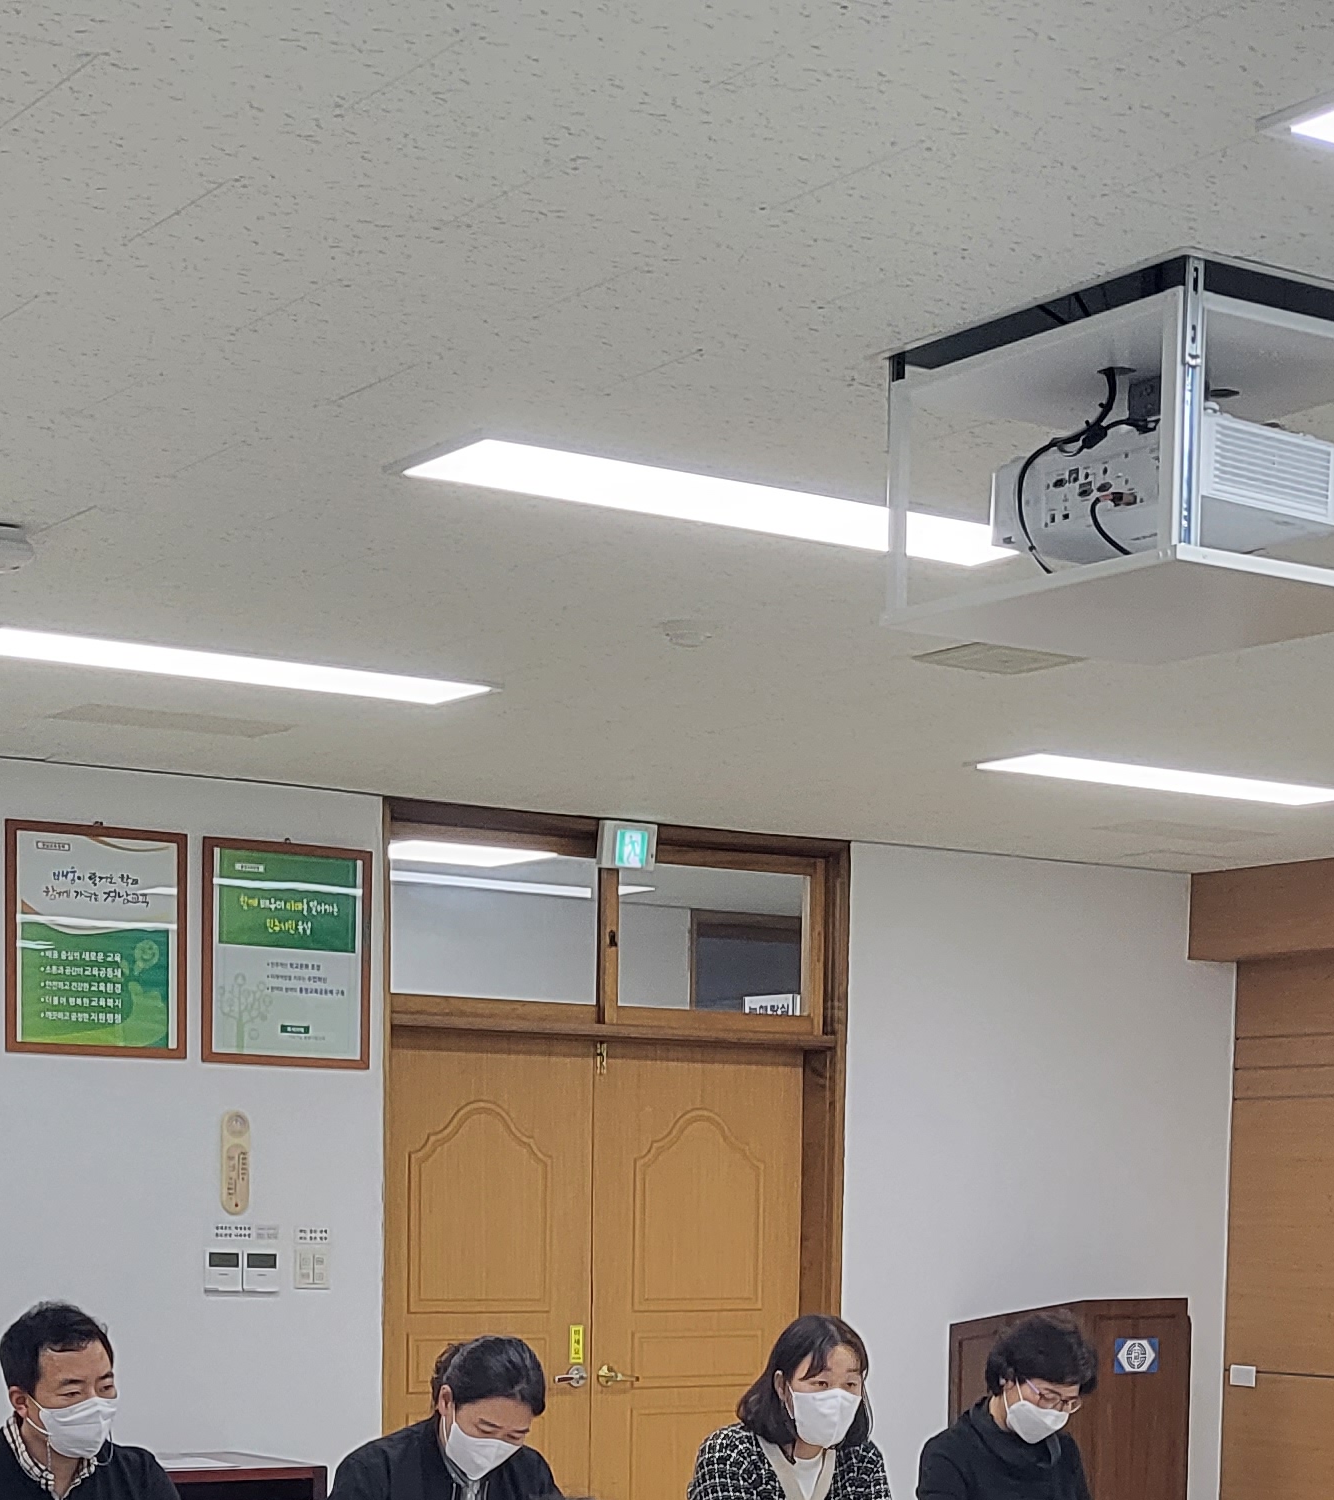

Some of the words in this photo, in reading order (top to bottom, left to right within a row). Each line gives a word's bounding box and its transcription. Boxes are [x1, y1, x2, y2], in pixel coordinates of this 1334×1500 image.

[119, 873, 139, 887] 학교
[43, 885, 71, 901] 함께
[103, 889, 149, 907] 경남교육
[82, 951, 105, 962] 새로운
[107, 952, 121, 963] 교육
